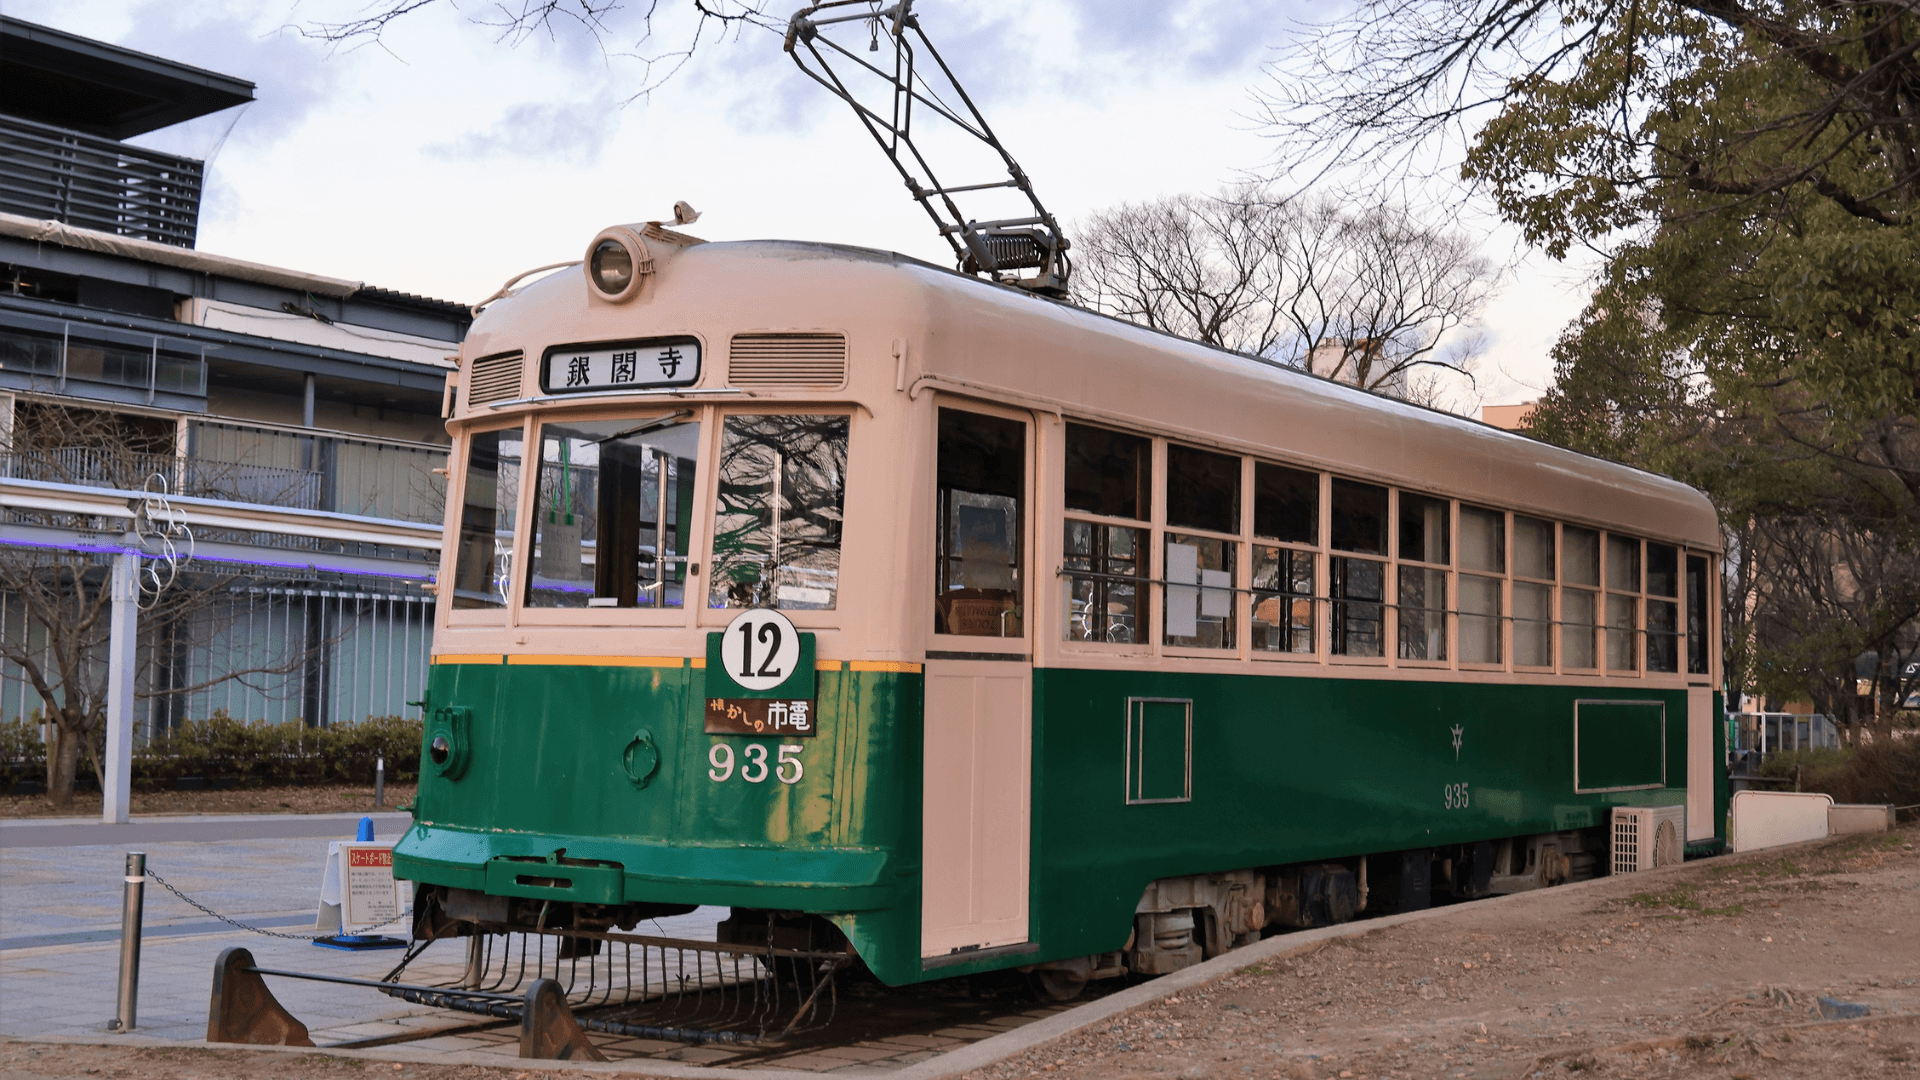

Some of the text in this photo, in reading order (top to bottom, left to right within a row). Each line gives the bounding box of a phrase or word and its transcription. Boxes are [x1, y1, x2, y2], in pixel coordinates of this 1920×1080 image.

[566, 346, 683, 388] 銀閣寺
[738, 622, 782, 677] 12
[708, 743, 804, 784] 935
[1444, 782, 1469, 810] 935
